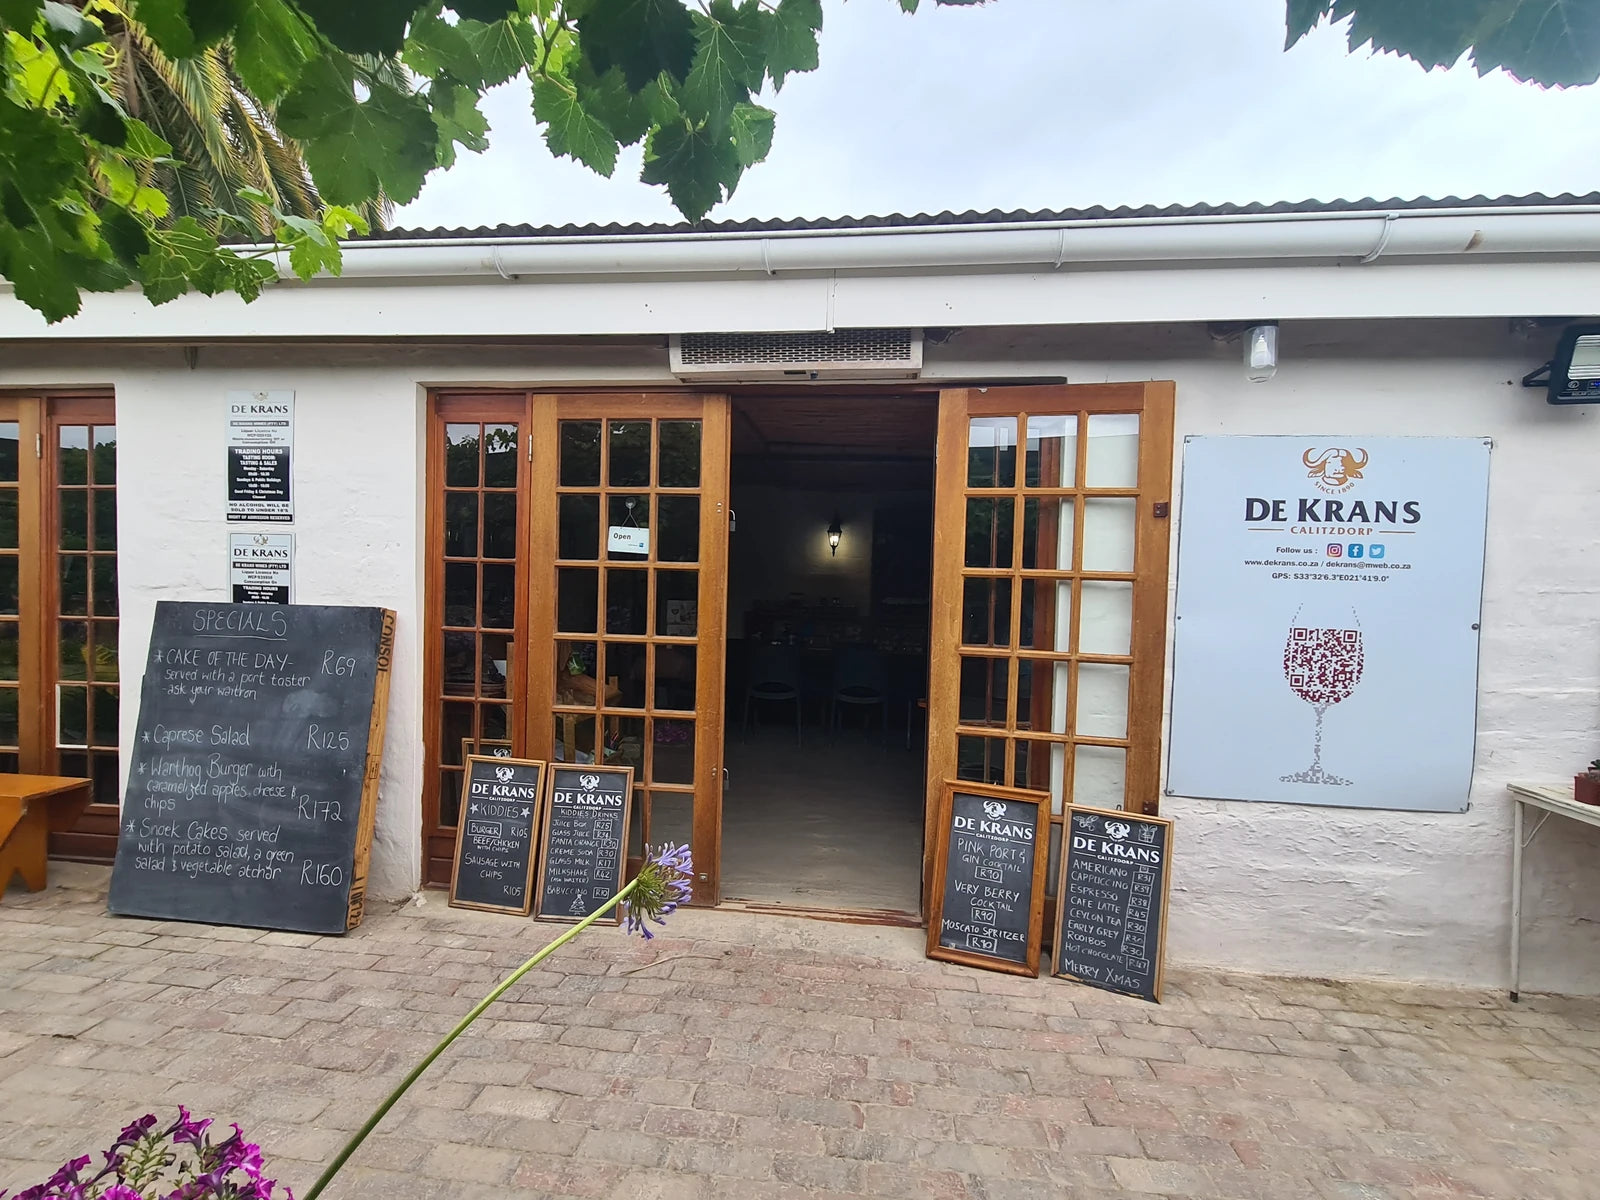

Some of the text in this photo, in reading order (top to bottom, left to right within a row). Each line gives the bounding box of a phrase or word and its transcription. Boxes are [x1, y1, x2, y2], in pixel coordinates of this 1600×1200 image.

[232, 405, 288, 413] DE KRANS
[1314, 481, 1355, 494] SINCE 1890
[1245, 497, 1421, 524] DE KRANS
[613, 532, 631, 540] Open
[1290, 526, 1373, 535] CALITZDORP
[252, 549, 288, 557] KRANS
[1244, 559, 1319, 567] www.dekrans.co.za
[1326, 561, 1411, 569] dekrans@mweb.co.za
[193, 610, 287, 637] SPECIALS
[166, 649, 201, 666] CAKE
[208, 651, 220, 665] OF
[225, 652, 248, 668] THE
[321, 649, 356, 677] R69
[202, 670, 224, 682] with
[228, 674, 234, 682] a
[240, 672, 266, 691] port
[271, 674, 310, 687] taster
[191, 686, 214, 704] your
[218, 684, 257, 700] waitron
[153, 723, 251, 751] Caprese Salad
[307, 724, 349, 751] R125
[151, 753, 282, 786] Warthog Burger with
[147, 779, 207, 801] caramelized
[254, 783, 286, 798] cheese
[472, 783, 535, 799] DE KRANS
[554, 792, 622, 807] DE KRANS
[145, 796, 176, 817] chips
[298, 794, 343, 823] R172
[480, 802, 519, 818] KIDDIES
[561, 809, 618, 819] KIDDIES DRINKS
[139, 819, 281, 844] Snoek Cakes served
[471, 822, 528, 839] BURGER R105
[552, 820, 610, 829] JUICE BOX R25
[552, 829, 570, 837] GLASS
[954, 816, 1033, 840] DE KRANS
[473, 836, 520, 850] BEEF/CHICKEN
[551, 837, 617, 848] FANTA ORANGE R30
[976, 833, 1010, 843] CALITZDORP
[138, 839, 165, 854] with
[173, 844, 210, 858] potato
[254, 849, 262, 859] a
[266, 850, 295, 870] green
[550, 848, 574, 856] CREME
[598, 850, 614, 858] R30
[957, 838, 985, 856] PINK
[990, 844, 1016, 860] PORT
[1073, 836, 1160, 864] DE KRANS
[135, 857, 165, 872] salad
[180, 860, 232, 878] vegetable
[239, 863, 281, 880] atchar
[465, 852, 520, 869] SAUSAGE WITH
[549, 857, 572, 865] GLASS
[598, 858, 612, 867] R17
[962, 854, 1022, 873] GIN COCKTAIL
[1097, 855, 1134, 865] CALITZDORP
[301, 860, 343, 887] R160
[480, 869, 503, 880] CHIPS
[548, 868, 588, 876] MILKSHAKE
[980, 868, 1000, 880] R90
[1071, 871, 1129, 890] CAPPUCCINO
[1073, 859, 1152, 883] AMERICANO R31
[503, 885, 521, 897] R105
[595, 889, 608, 897] R10
[954, 880, 1020, 903] VERY BERRY
[1070, 883, 1148, 907] ESPRESSO R38
[970, 897, 1014, 912] COCKTAIL
[1070, 896, 1146, 919] CAFE LATTE R45
[975, 910, 994, 921] R90
[1070, 907, 1145, 932] CEYLON TEA R30
[941, 919, 1025, 943] MOSCATO SPRITZER
[1068, 919, 1143, 943] EARLY GREY R30
[972, 936, 993, 950] R90
[1067, 931, 1143, 956] ROOIBOS R30
[1065, 942, 1081, 954] HOT
[1081, 947, 1124, 964] CHOCOLATE
[1064, 958, 1141, 989] MERRY XMAS
